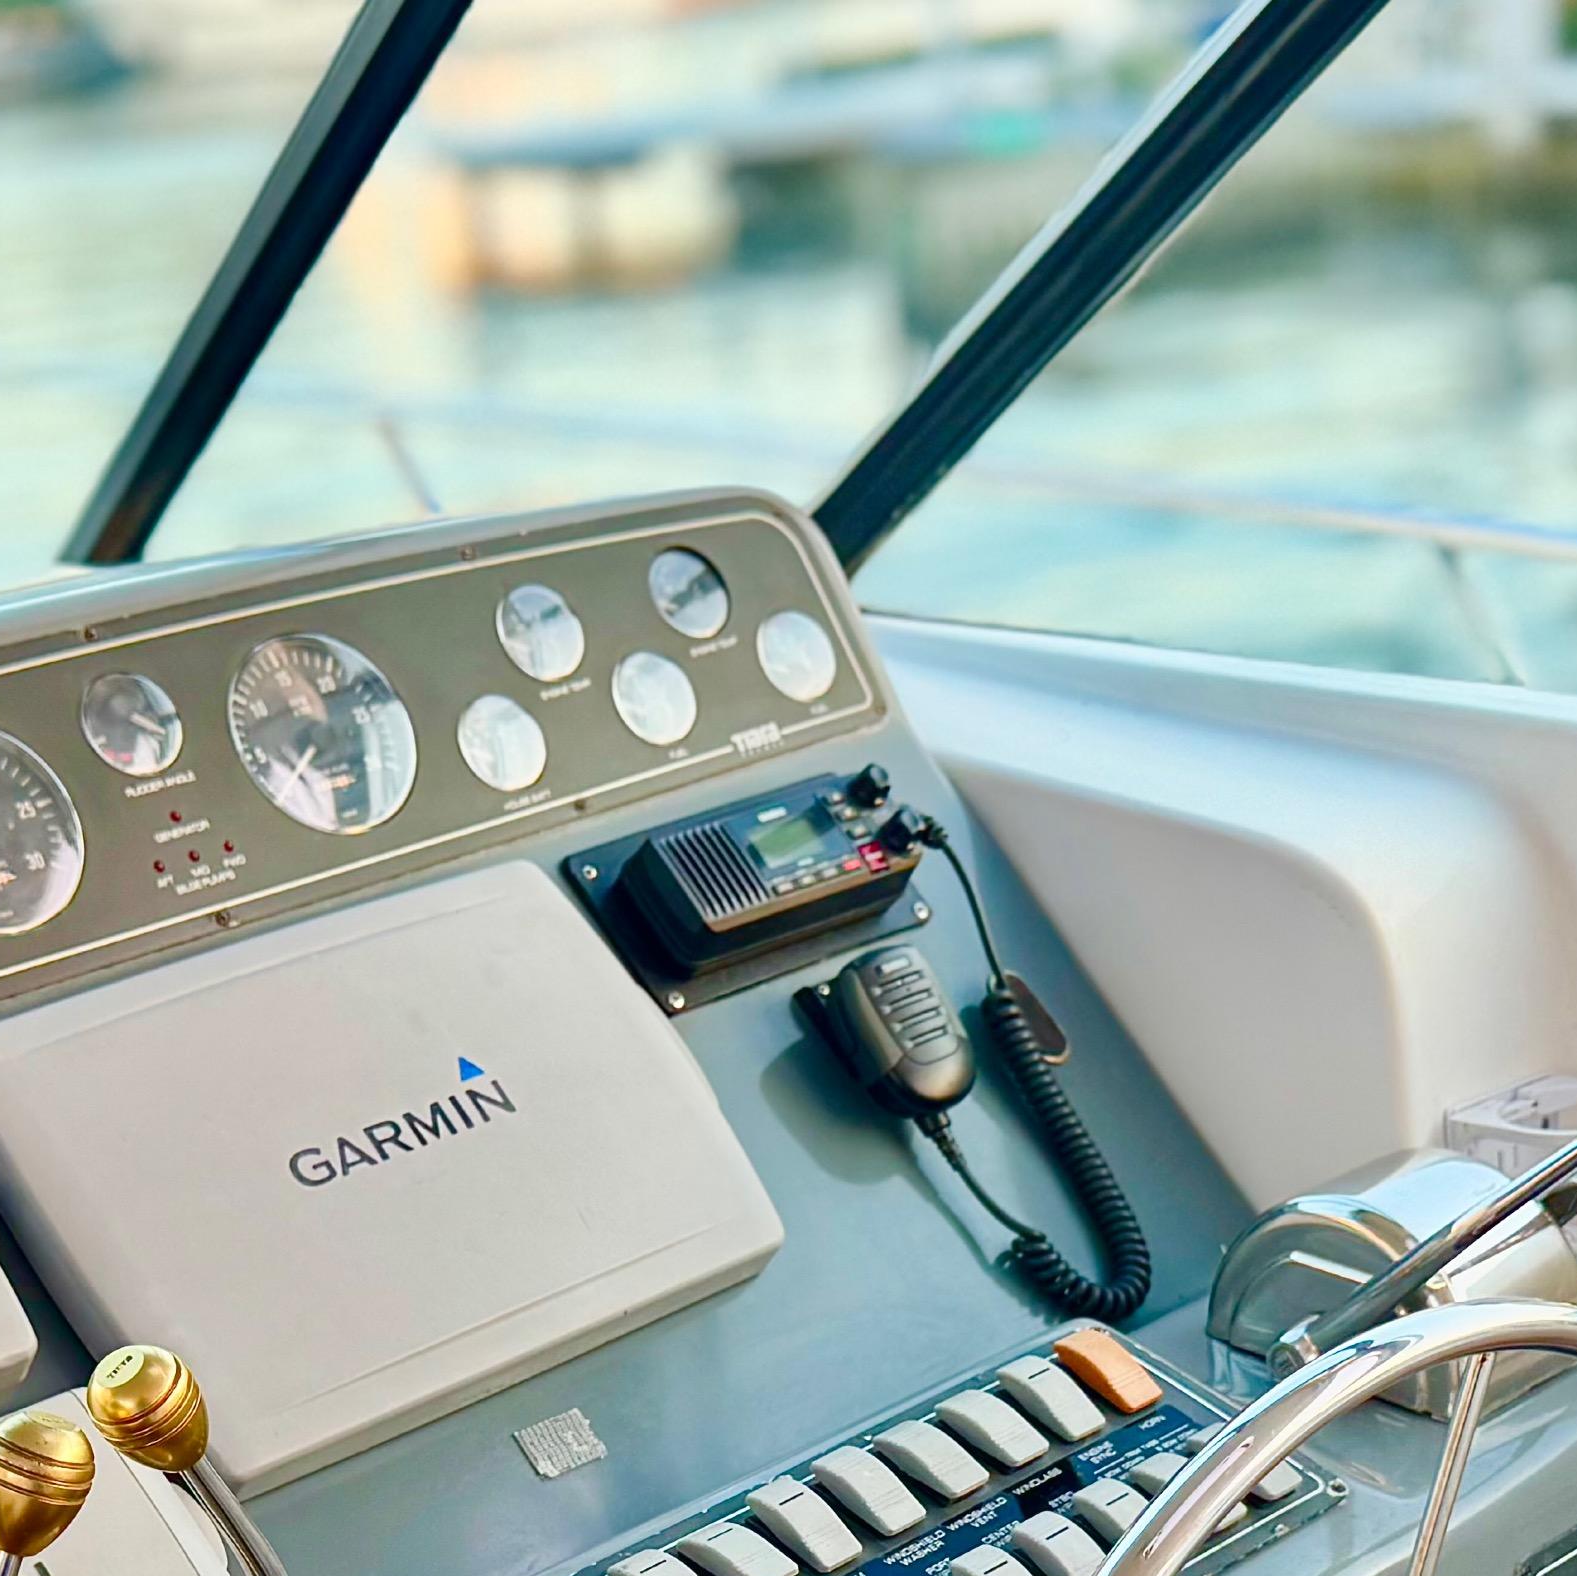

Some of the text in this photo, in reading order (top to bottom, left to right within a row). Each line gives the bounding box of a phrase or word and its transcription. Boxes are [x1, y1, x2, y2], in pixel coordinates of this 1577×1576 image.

[15, 800, 37, 819] 25
[153, 818, 210, 843] GENERATOR
[24, 851, 45, 871] 30
[288, 1079, 517, 1188] GARMIN
[1012, 1468, 1063, 1496] WINDLASS
[946, 1496, 1008, 1531] WINDSHIELD
[971, 1511, 998, 1528] VENT
[883, 1529, 946, 1565] WINDSHIELD
[899, 1541, 945, 1566] WASHER
